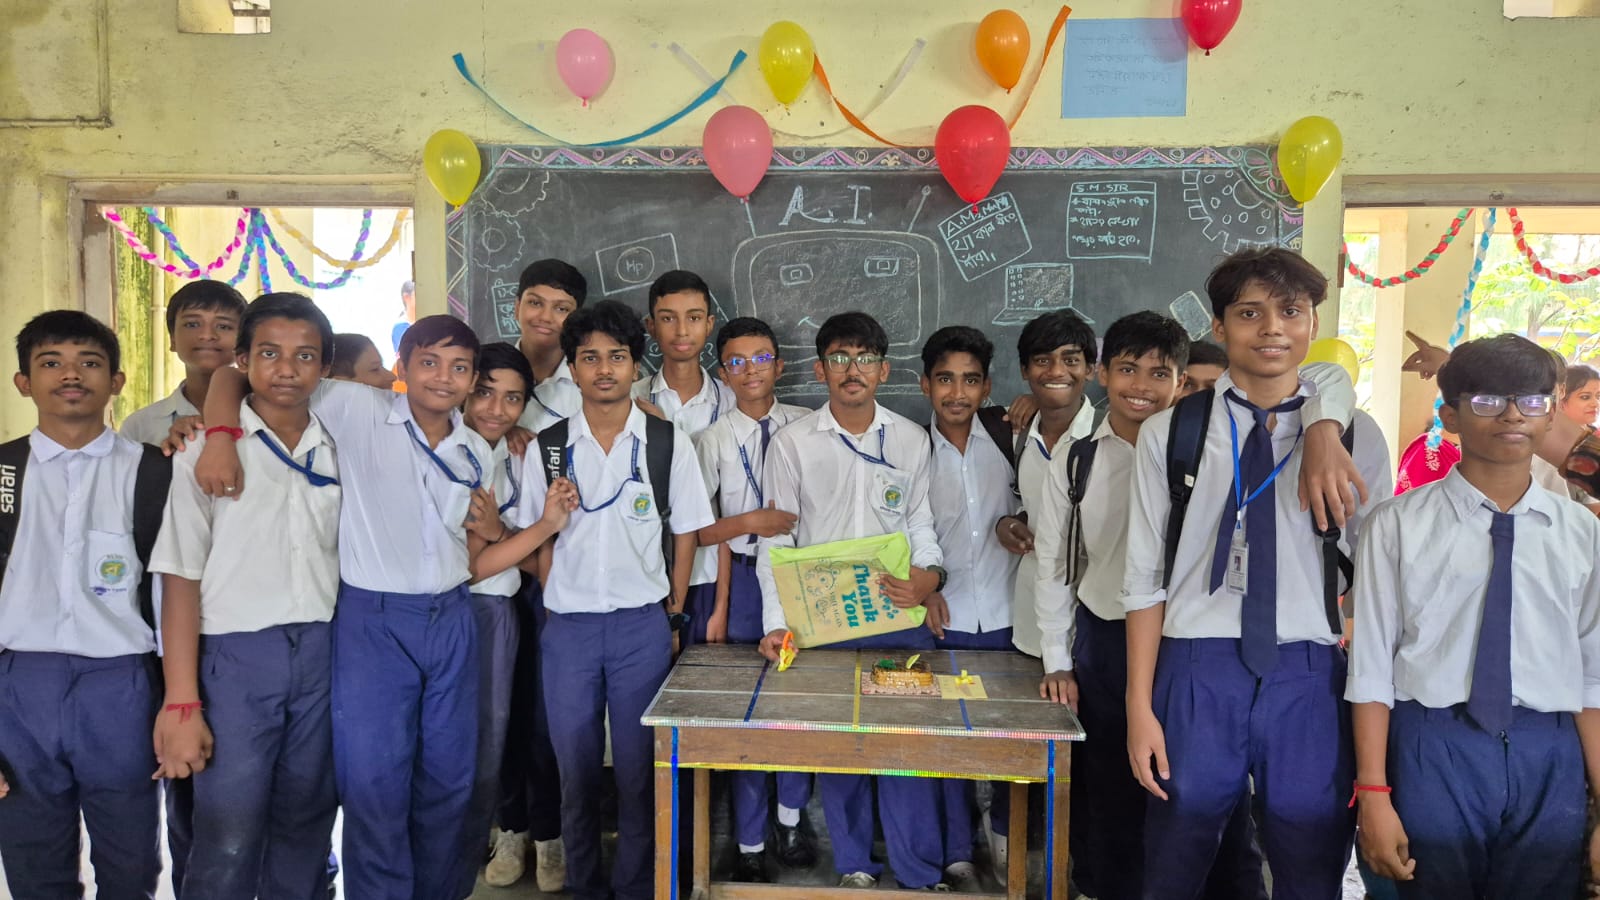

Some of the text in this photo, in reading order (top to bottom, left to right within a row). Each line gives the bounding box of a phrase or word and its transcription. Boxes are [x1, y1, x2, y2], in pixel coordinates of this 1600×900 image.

[547, 446, 561, 481] afari
[0, 464, 17, 514] safari
[842, 592, 860, 628] You
[853, 564, 879, 623] Thank
